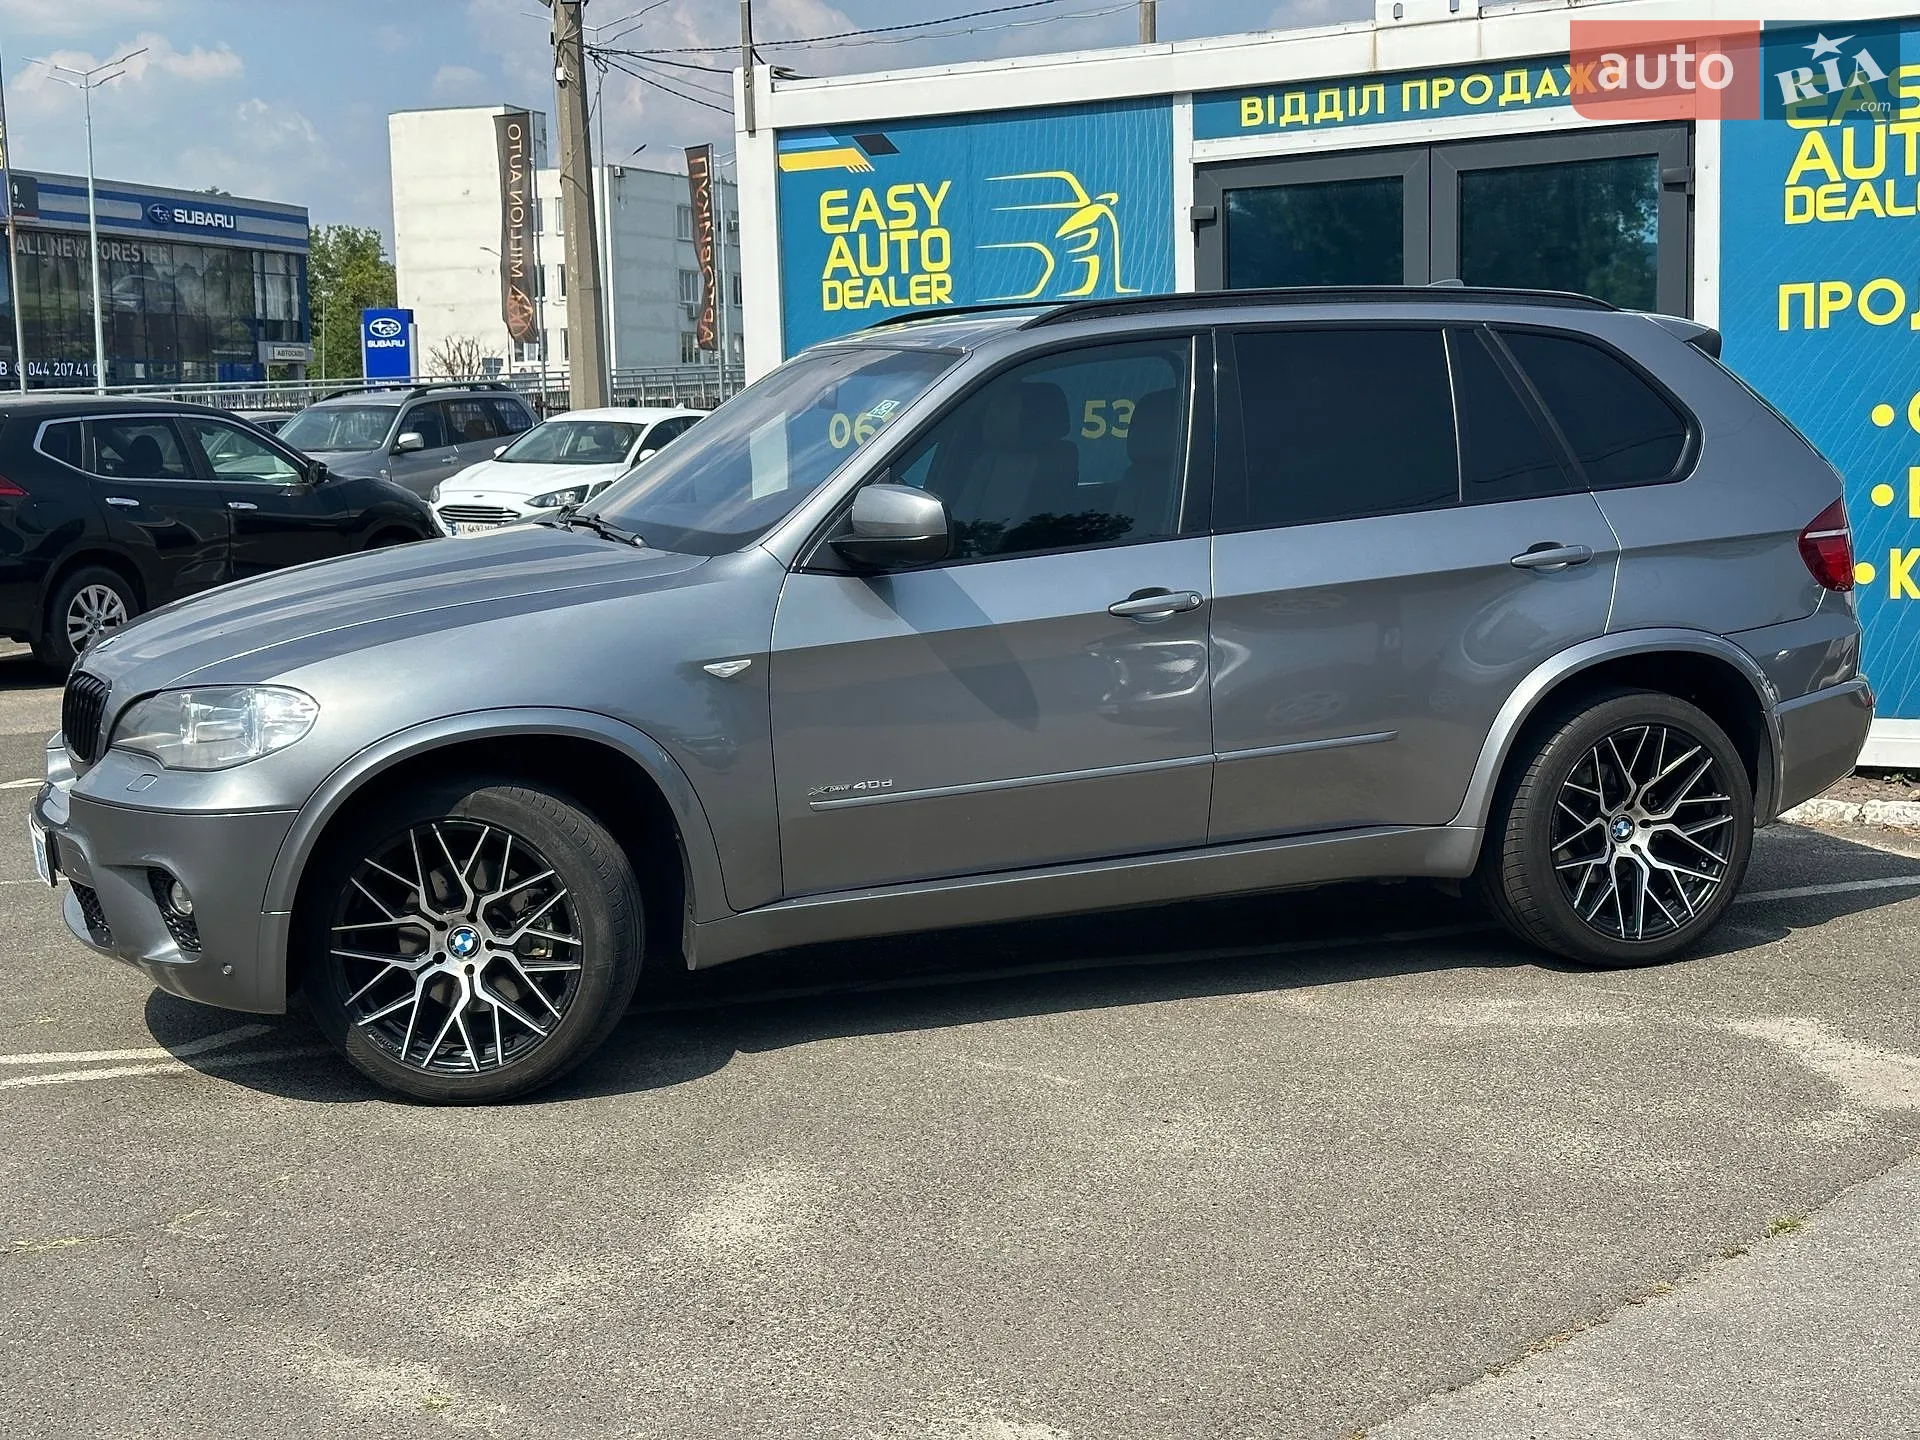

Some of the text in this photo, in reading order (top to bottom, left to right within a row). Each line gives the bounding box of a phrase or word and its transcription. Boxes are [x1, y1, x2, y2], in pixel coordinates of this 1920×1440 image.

[1241, 83, 1385, 127] ВІДДІЛ
[173, 208, 235, 229] SUBARU
[820, 181, 952, 234] EASY
[1785, 178, 1920, 225] DEAL
[16, 234, 169, 265] ALL NEW ORESTER
[822, 228, 951, 279] AUTO
[822, 272, 954, 311] DEALER
[1778, 277, 1920, 331] ПРО
[367, 339, 406, 348] SUBARU
[28, 361, 50, 376] 044
